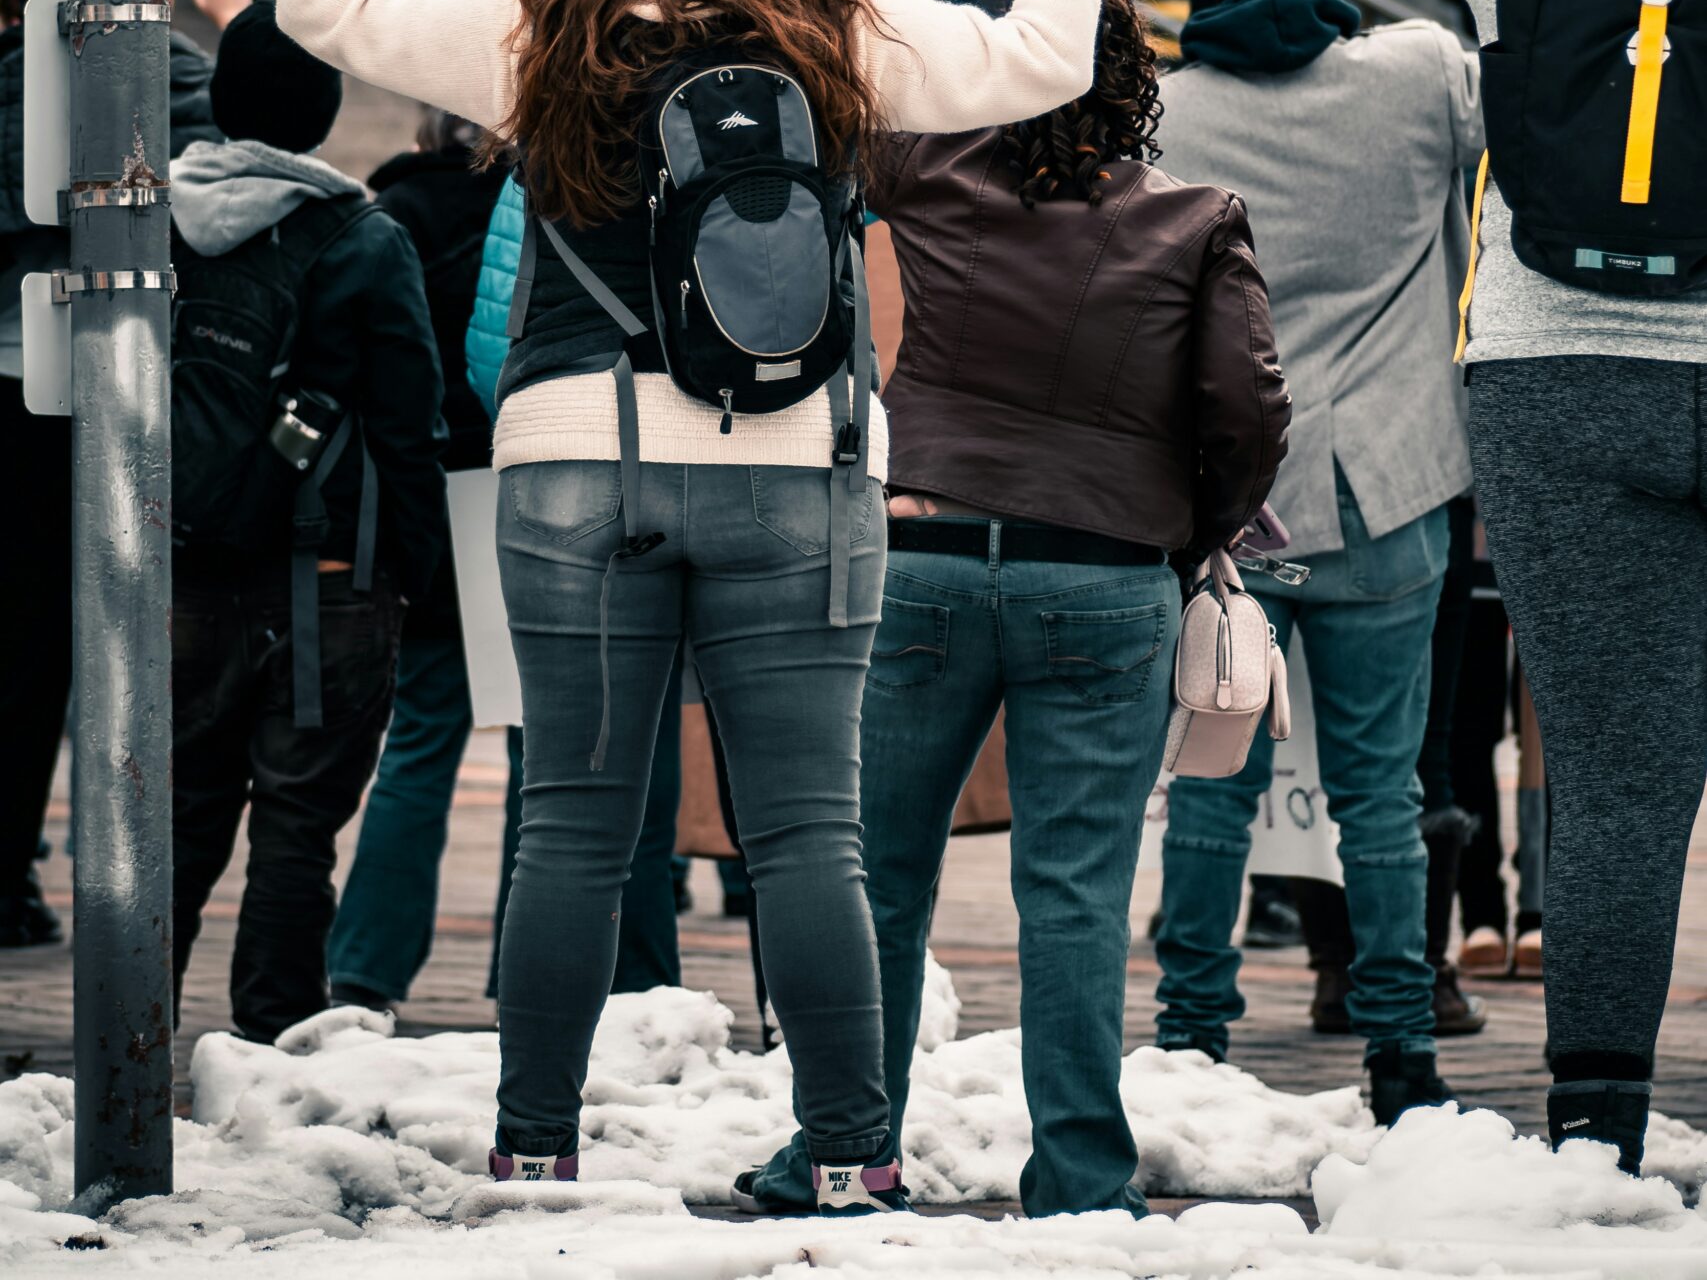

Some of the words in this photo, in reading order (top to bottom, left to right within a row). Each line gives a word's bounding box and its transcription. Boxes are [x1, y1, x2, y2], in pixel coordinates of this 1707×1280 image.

[1608, 257, 1642, 267] TIMBUK2
[522, 1161, 546, 1173] NIKE
[828, 1171, 852, 1182] NIKE
[831, 1182, 848, 1193] AIR
